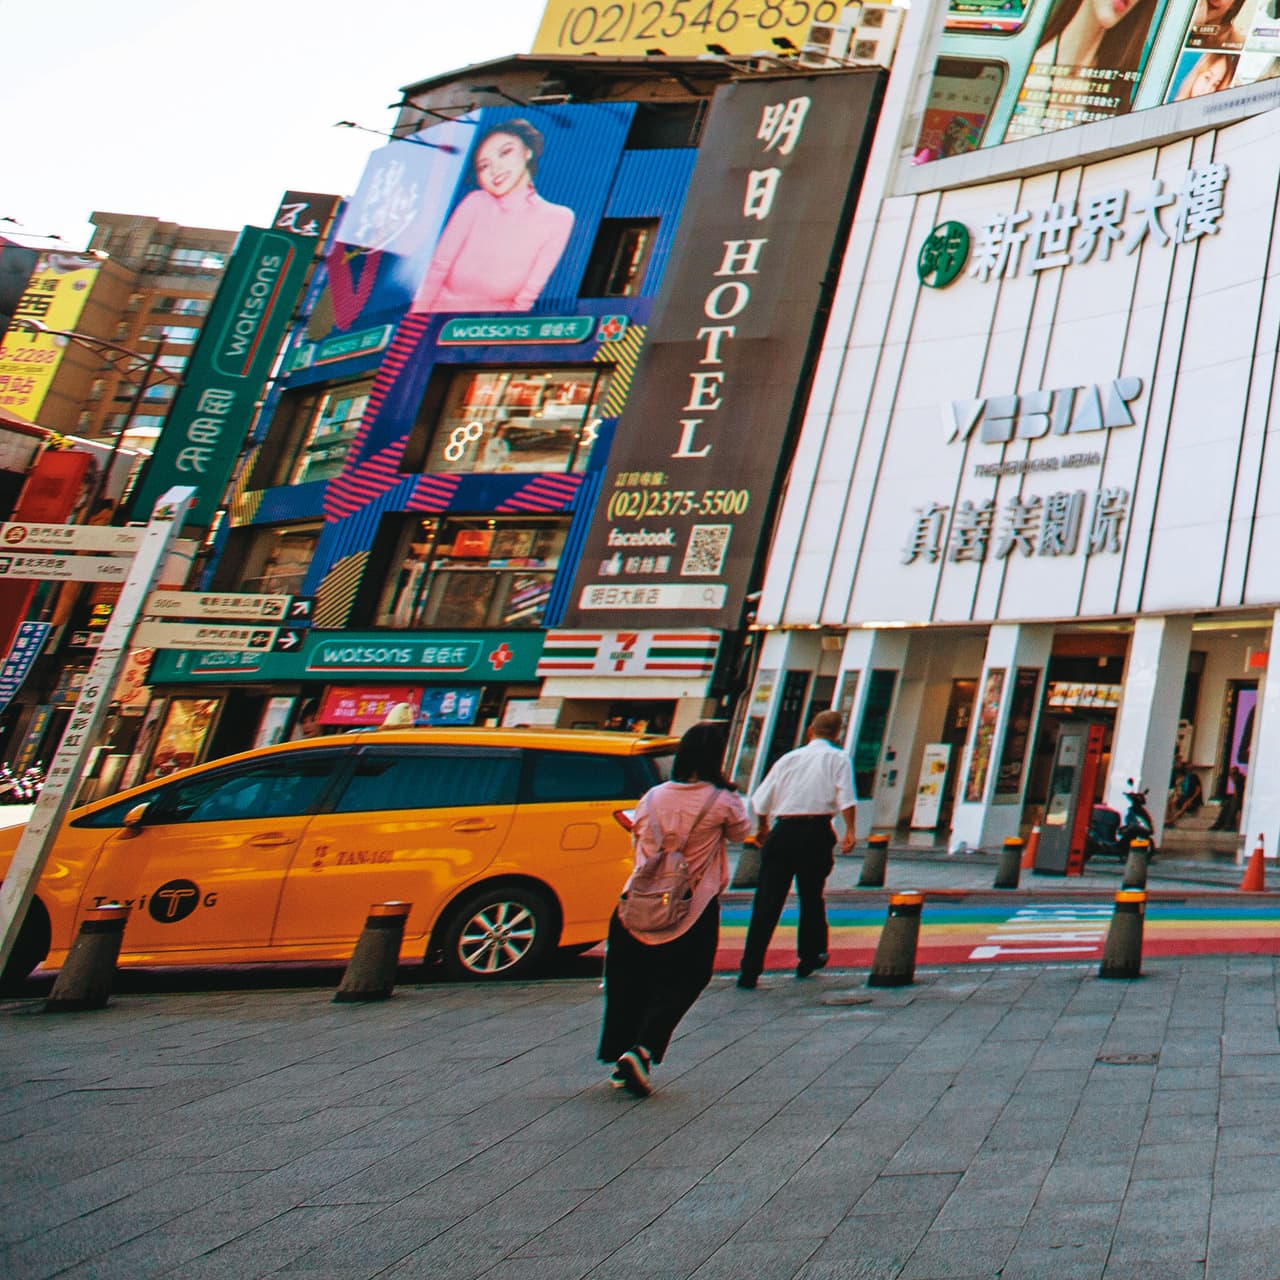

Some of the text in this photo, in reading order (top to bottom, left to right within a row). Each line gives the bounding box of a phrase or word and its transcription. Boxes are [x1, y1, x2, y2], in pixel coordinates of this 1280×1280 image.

[743, 94, 811, 222] 明日
[969, 162, 1229, 283] 新世界大樓
[225, 255, 281, 357] watsons
[452, 324, 529, 339] watsons
[671, 238, 762, 461] HOTEL
[607, 489, 750, 522] (02)2375-5500
[901, 487, 1130, 566] 真善美劇院
[590, 588, 661, 605] 明日大飯店
[323, 647, 411, 664] watsons
